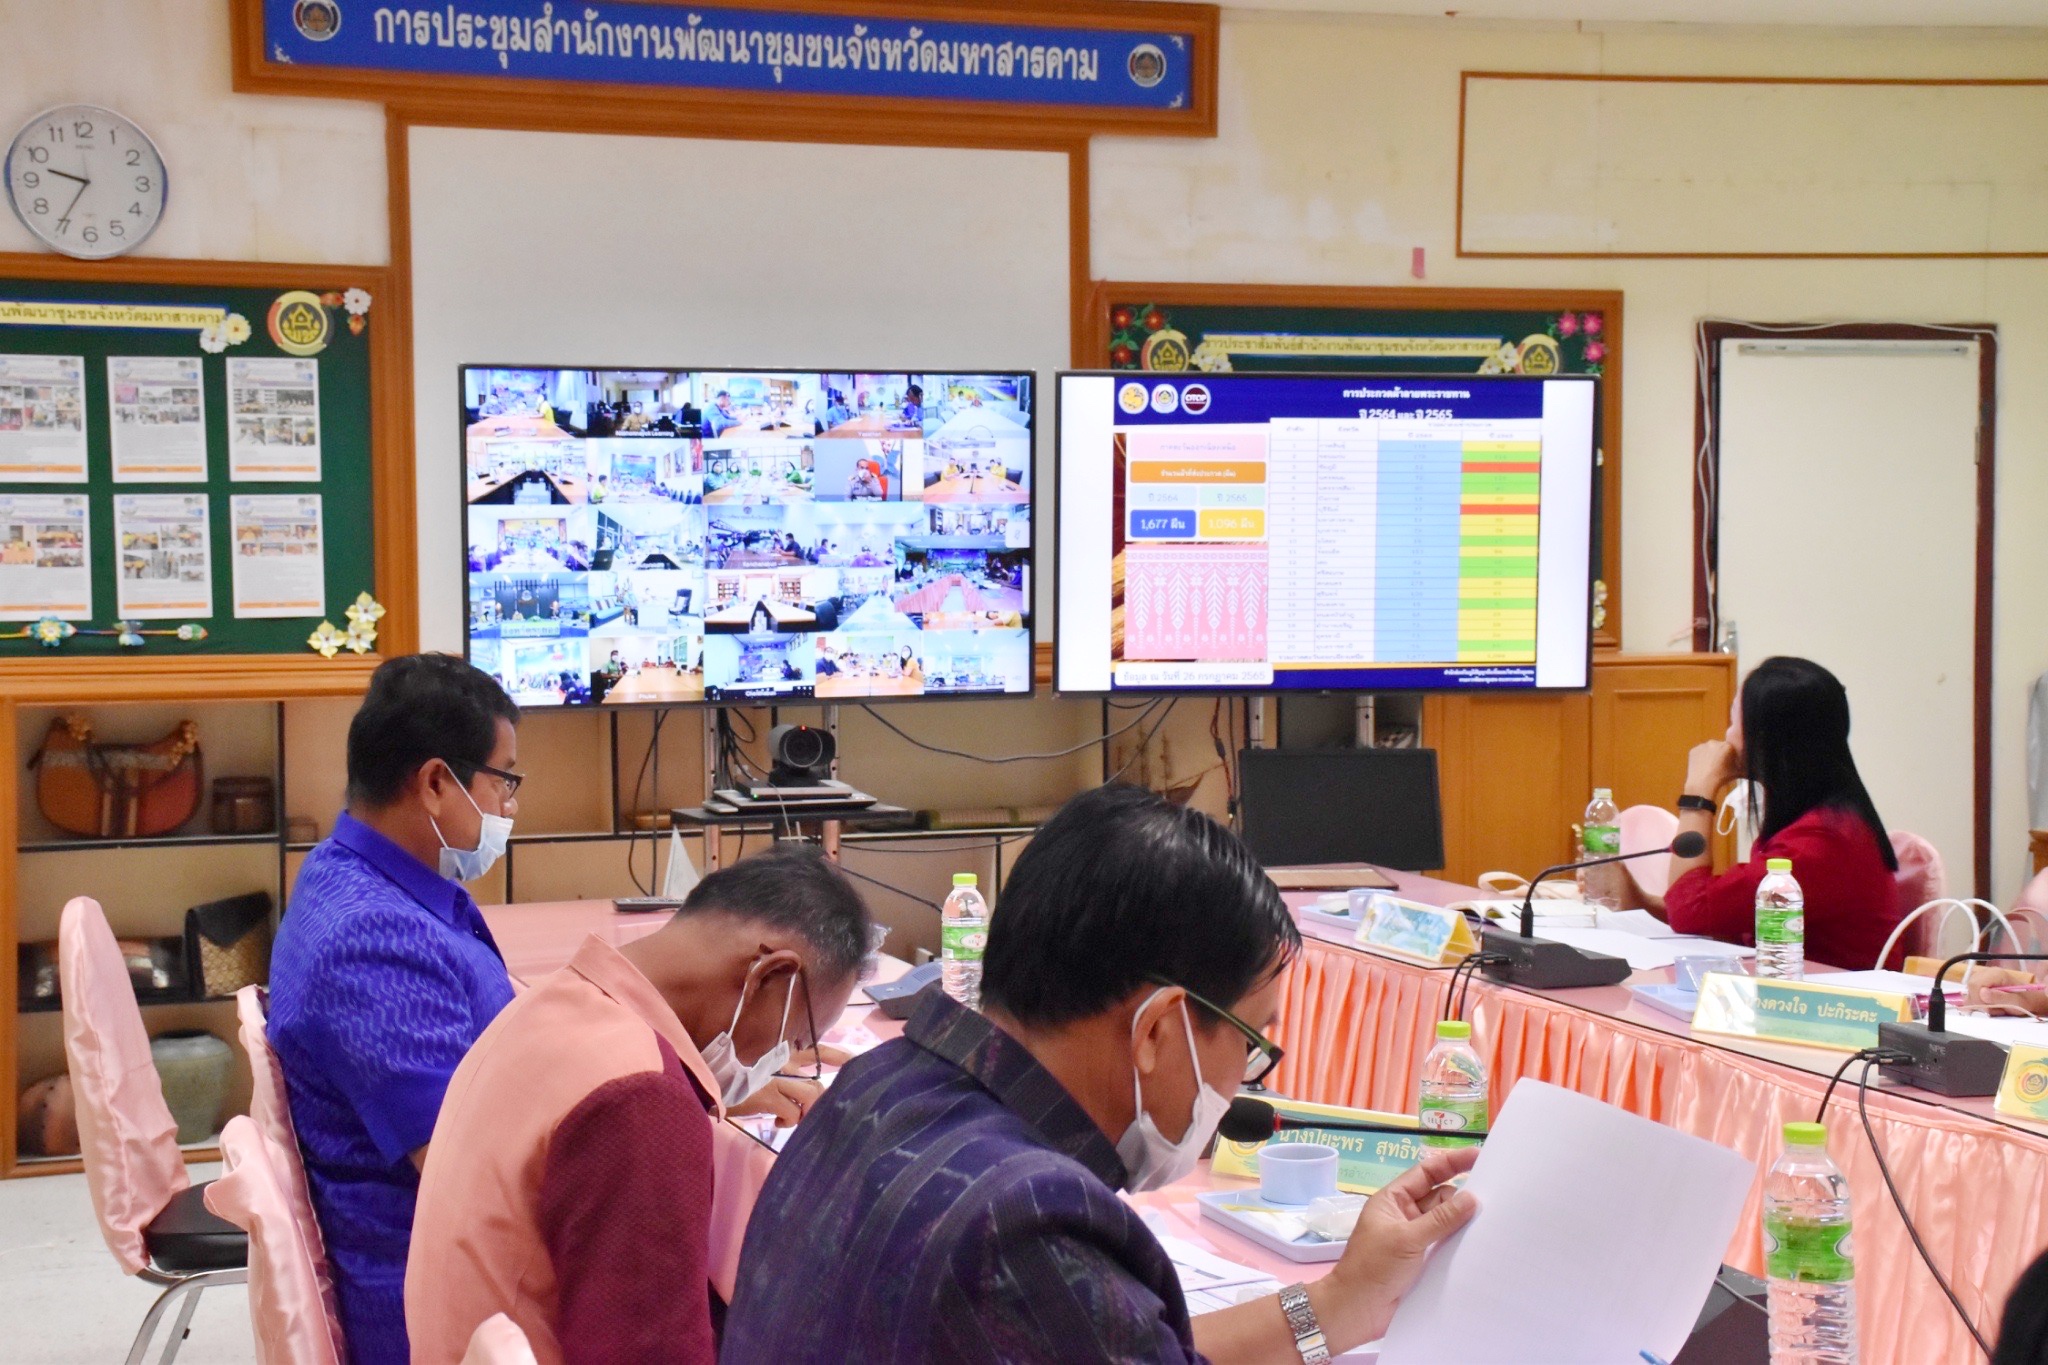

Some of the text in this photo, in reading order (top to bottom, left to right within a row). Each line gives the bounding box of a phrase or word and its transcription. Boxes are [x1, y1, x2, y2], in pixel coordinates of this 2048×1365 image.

[374, 2, 1098, 82] การประชุมสำนักงานพัฒนาชุมชนจังหวัดมหาสารคาม
[49, 127, 64, 142] 11
[73, 121, 94, 139] 12
[109, 129, 116, 145] 1
[28, 146, 49, 163] 10
[126, 149, 140, 166] 2
[23, 171, 40, 188] 9
[135, 176, 150, 192] 3
[34, 197, 49, 214] 8
[128, 202, 143, 216] 4
[57, 218, 71, 235] 7
[83, 226, 98, 242] 6
[109, 220, 125, 236] 5
[1368, 409, 1396, 419] 2564
[1425, 409, 1453, 419] 2565
[1157, 494, 1178, 502] 2564
[1226, 494, 1247, 502] 2565
[1140, 517, 1185, 531] 1,677 ผืน
[1183, 672, 1195, 681] 26
[1241, 671, 1265, 681] 2565
[1427, 1116, 1454, 1125] SELECT
